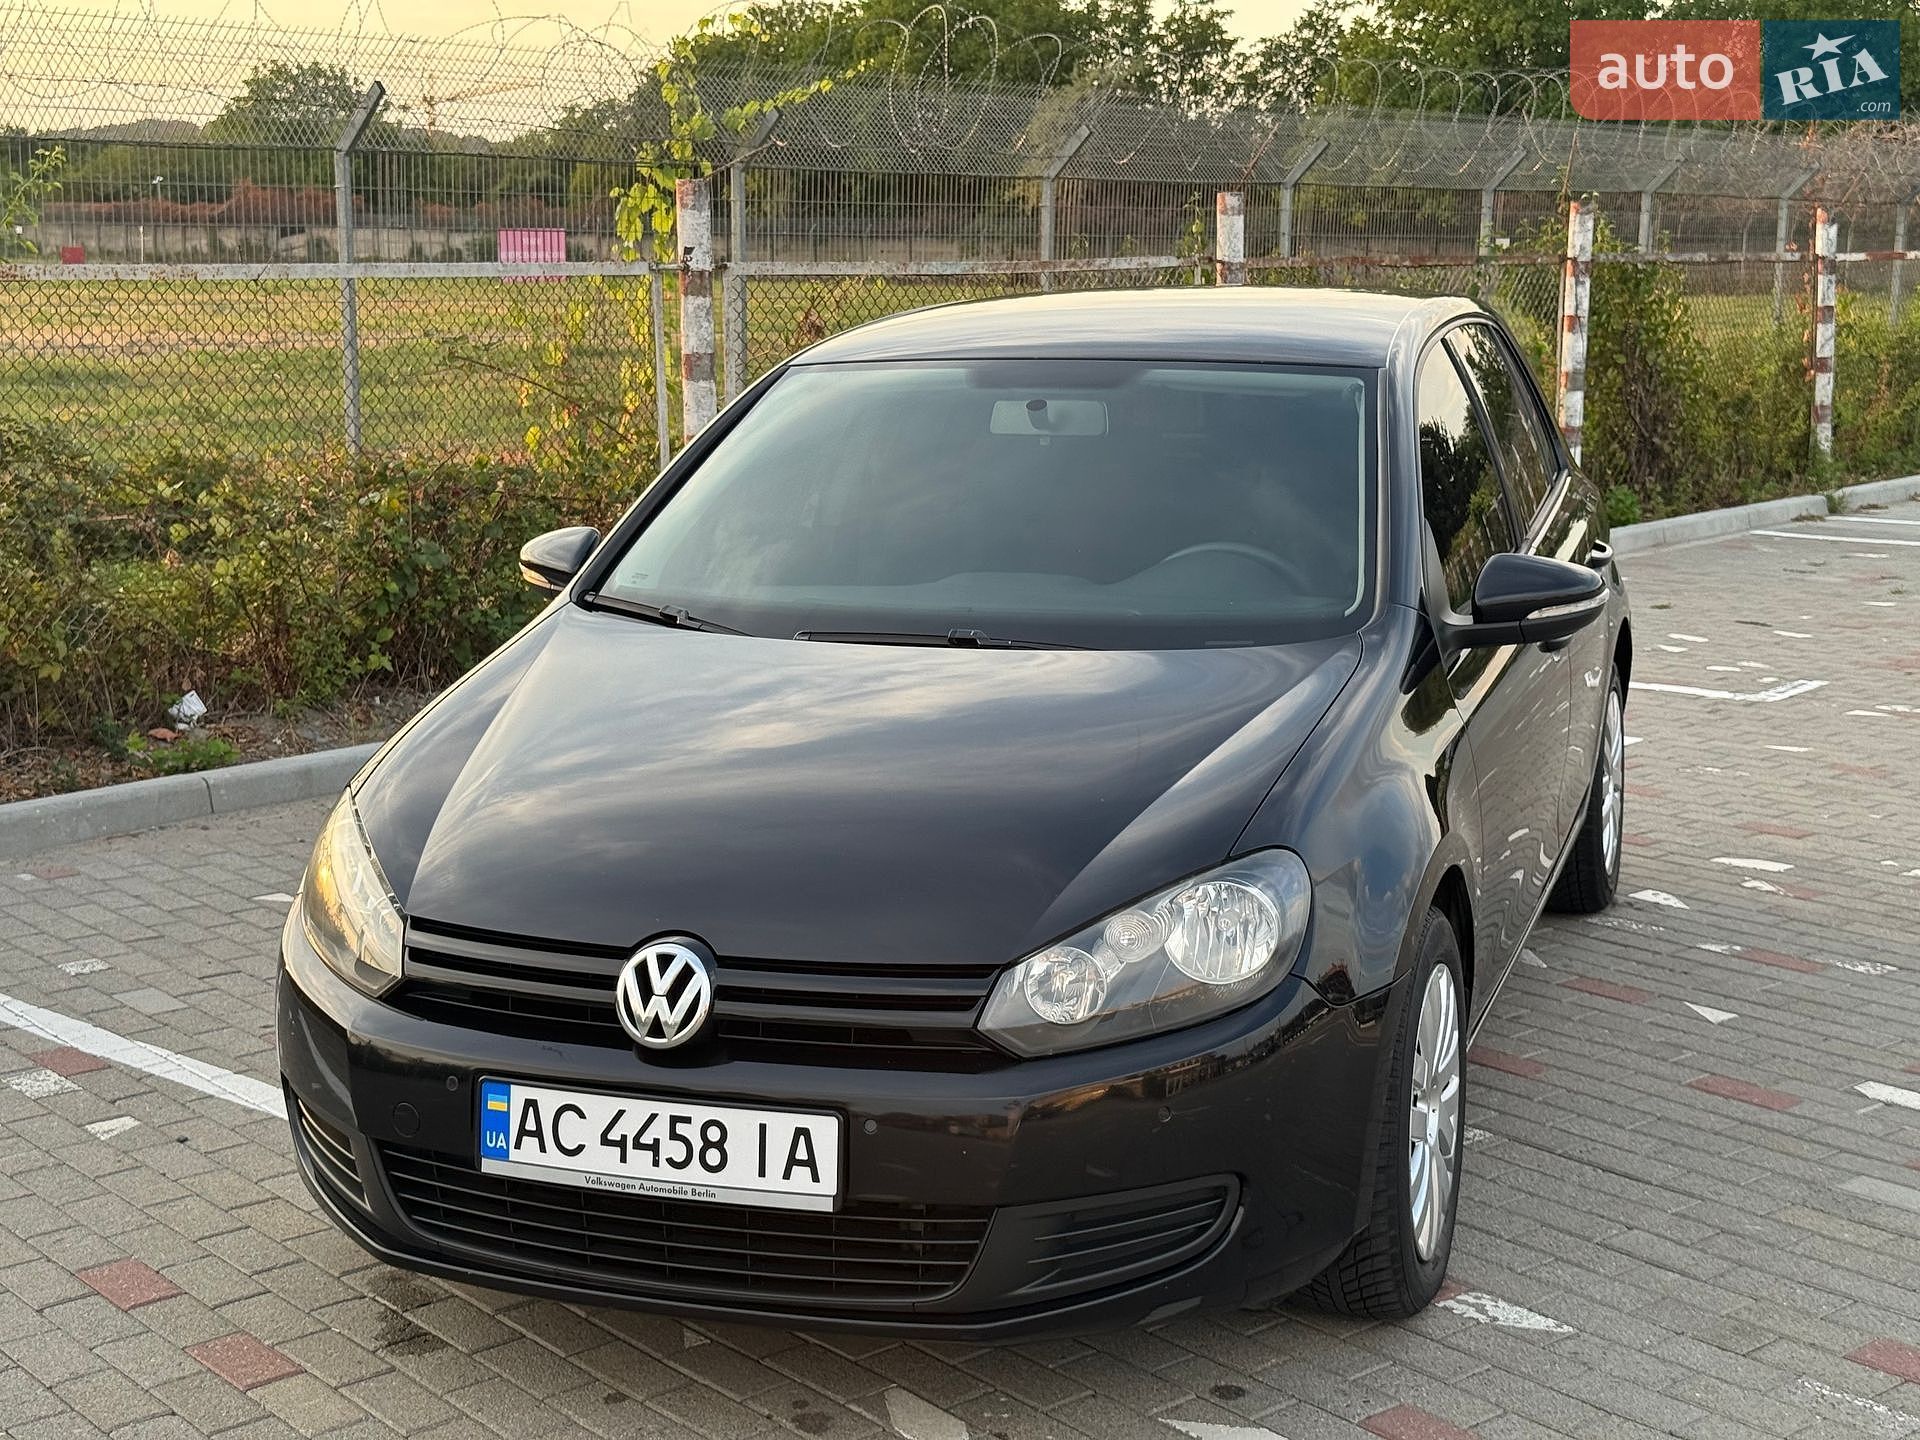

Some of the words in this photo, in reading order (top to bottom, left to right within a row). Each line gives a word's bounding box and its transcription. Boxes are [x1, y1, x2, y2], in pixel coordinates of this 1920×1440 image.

[486, 1130, 507, 1150] UA
[513, 1098, 587, 1157] AC
[600, 1109, 728, 1174] 4458
[757, 1122, 821, 1183] IA
[584, 1175, 636, 1190] Volkswagen
[638, 1182, 688, 1196] Automobile
[691, 1188, 716, 1199] Berlin
